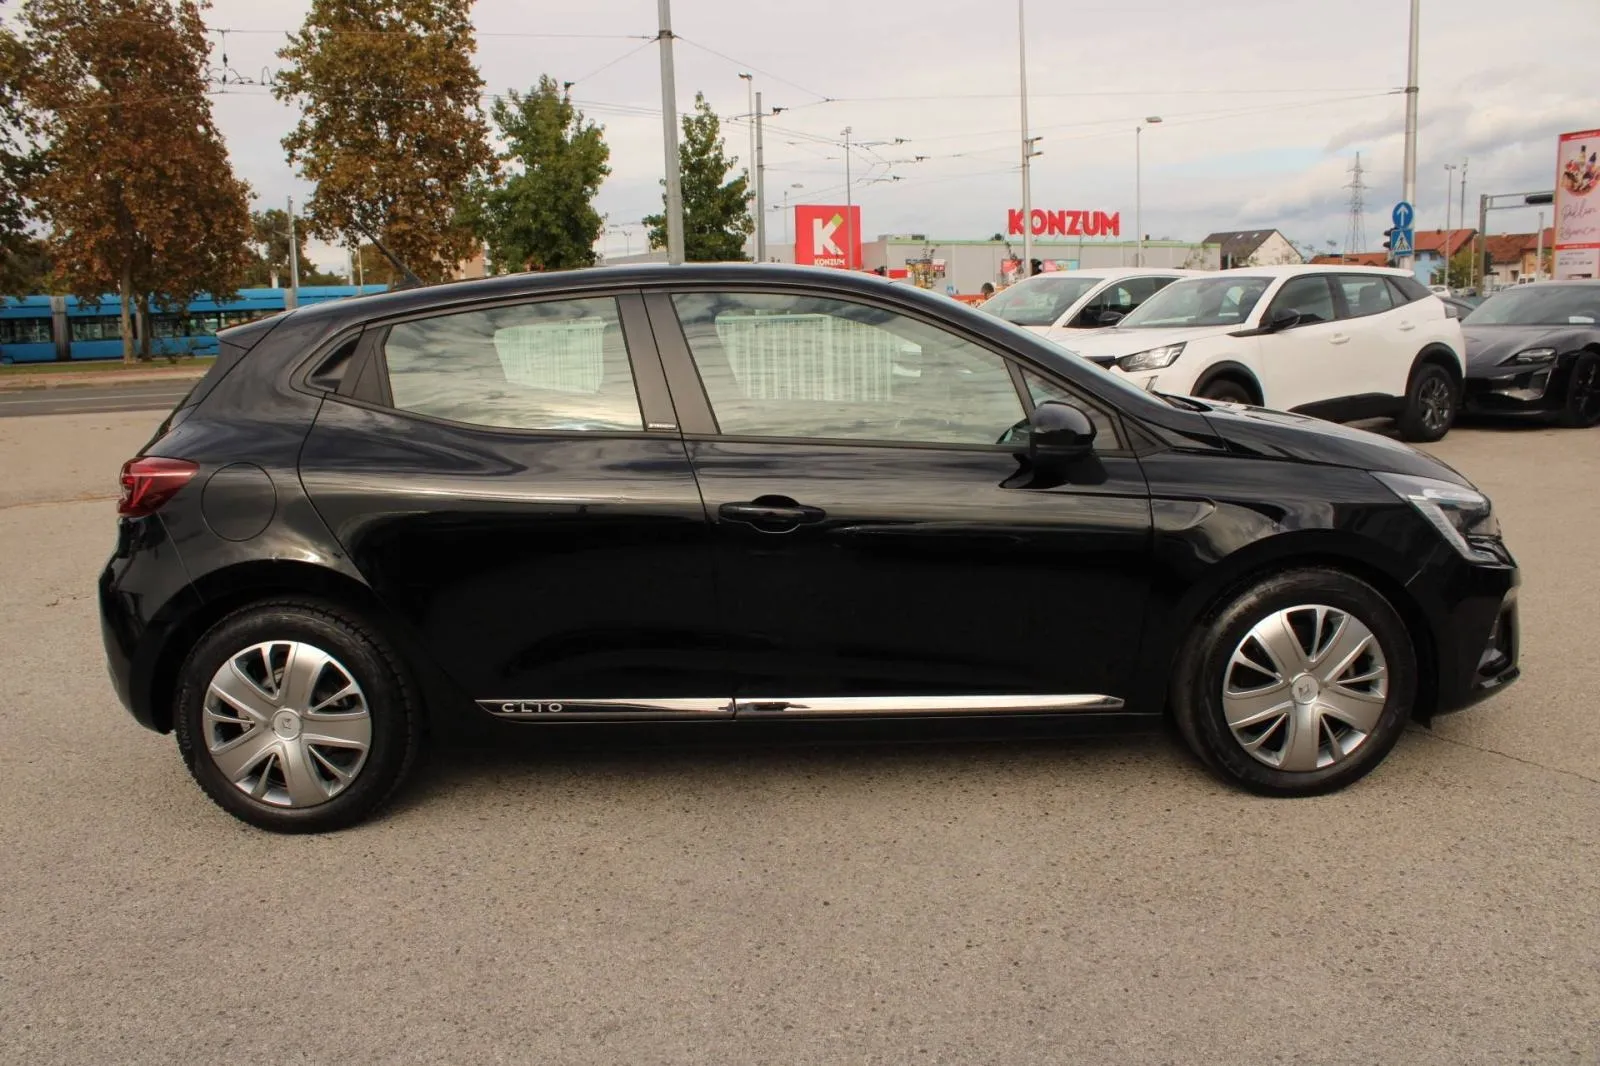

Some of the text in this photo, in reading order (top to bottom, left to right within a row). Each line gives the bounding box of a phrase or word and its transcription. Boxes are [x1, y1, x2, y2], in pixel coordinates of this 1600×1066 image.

[1008, 208, 1120, 236] KONZUM
[813, 213, 844, 256] K
[814, 257, 846, 266] KONZUM
[501, 703, 563, 712] CLIO
